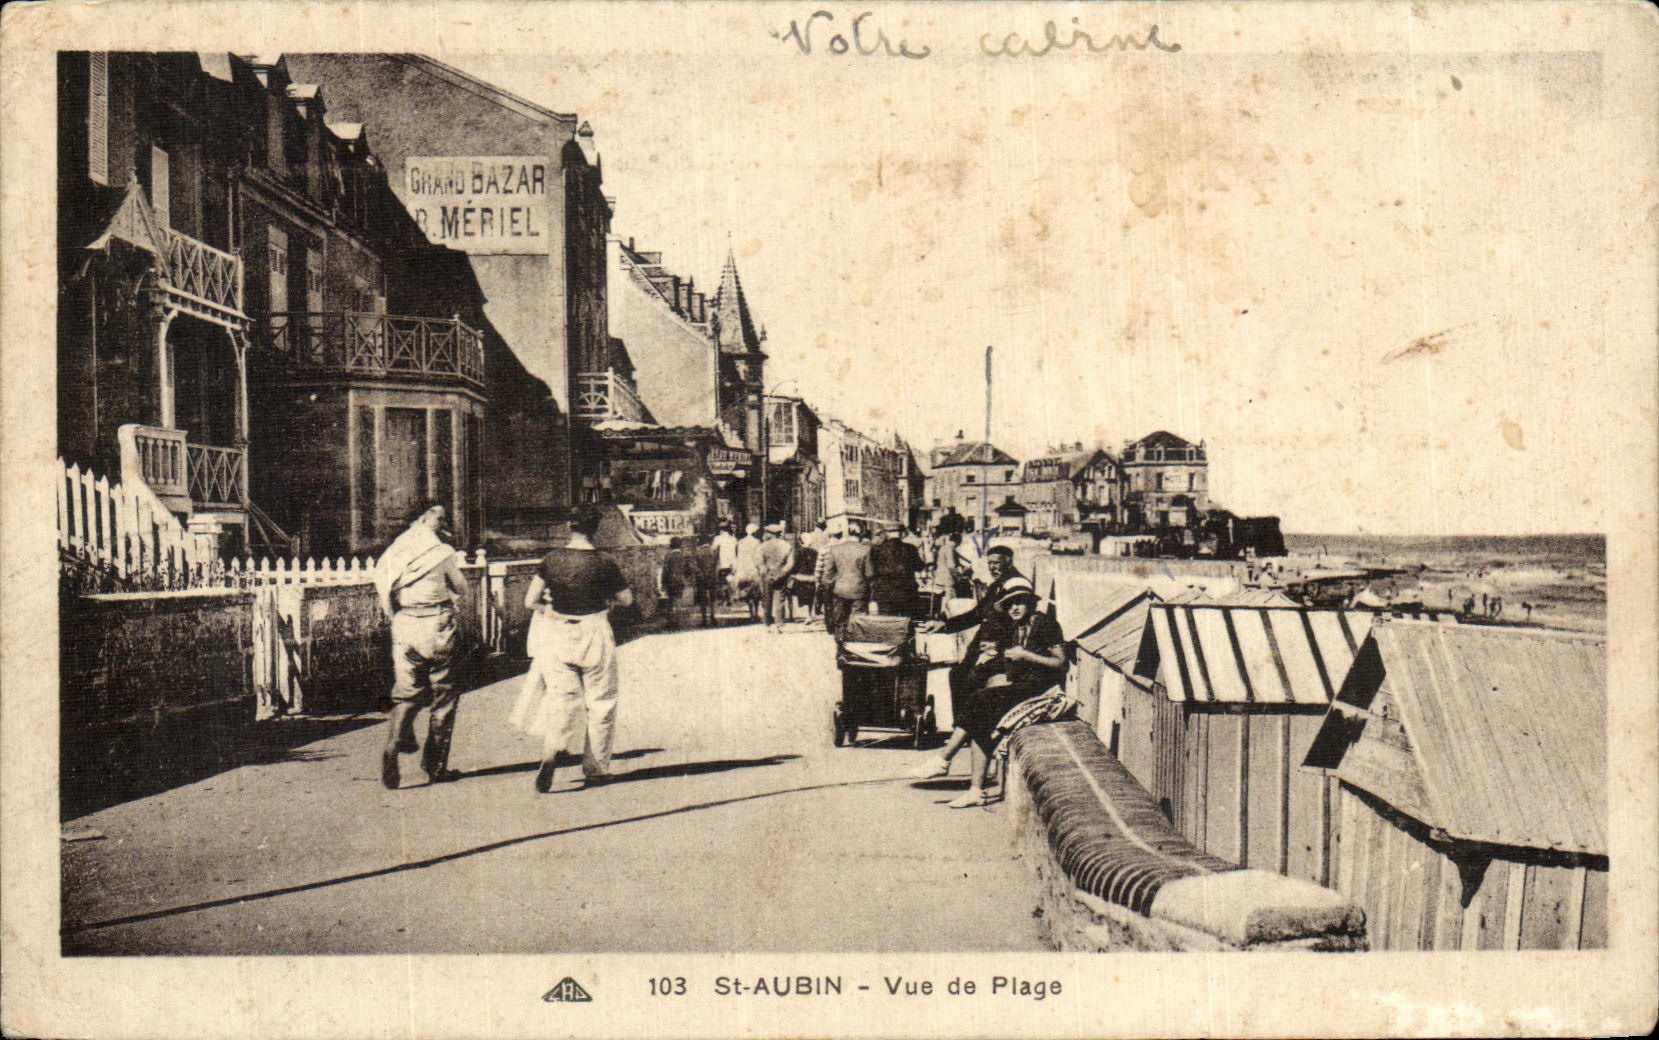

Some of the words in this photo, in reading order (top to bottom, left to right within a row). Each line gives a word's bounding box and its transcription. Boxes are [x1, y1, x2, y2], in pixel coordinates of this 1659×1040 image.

[410, 166, 465, 196] GRAND
[471, 162, 545, 195] BAZAR
[440, 199, 541, 240] MÉRIEL
